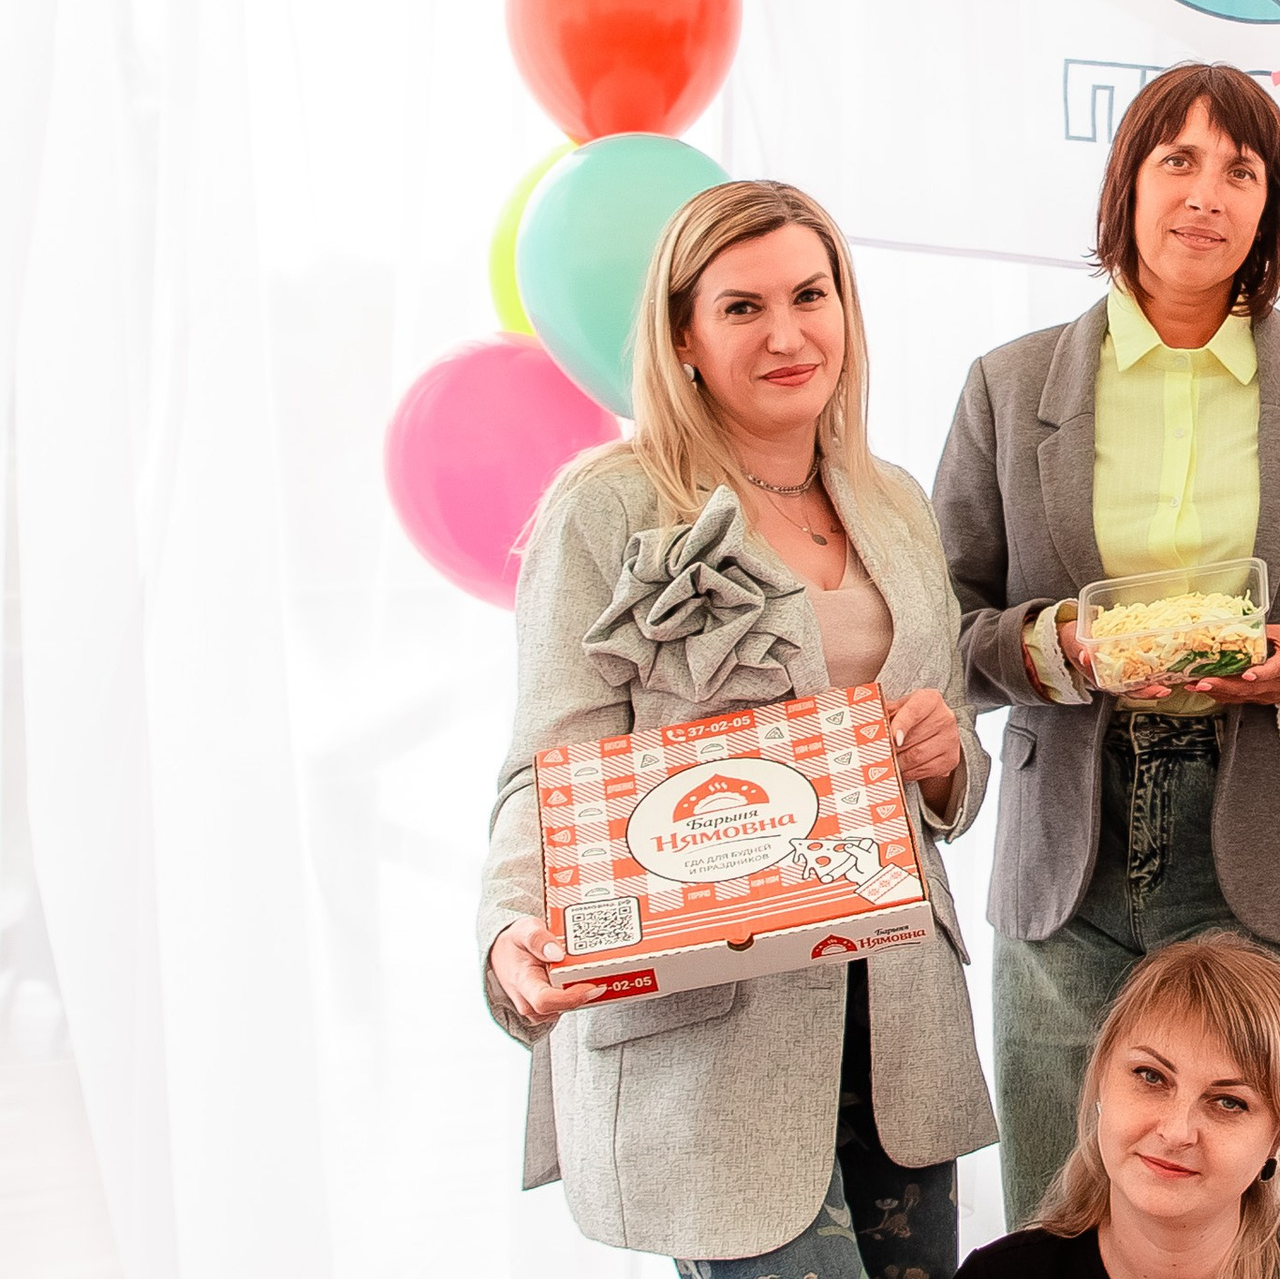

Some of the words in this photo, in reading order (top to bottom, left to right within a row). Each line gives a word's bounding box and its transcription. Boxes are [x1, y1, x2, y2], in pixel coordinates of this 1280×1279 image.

[688, 715, 751, 737] 37-02-05
[686, 809, 759, 830] Барыня
[650, 813, 798, 853] Нямовна
[706, 853, 729, 864] ДЛЯ
[689, 867, 697, 875] И
[858, 929, 926, 949] Нямовна
[598, 976, 652, 992] -02-05
